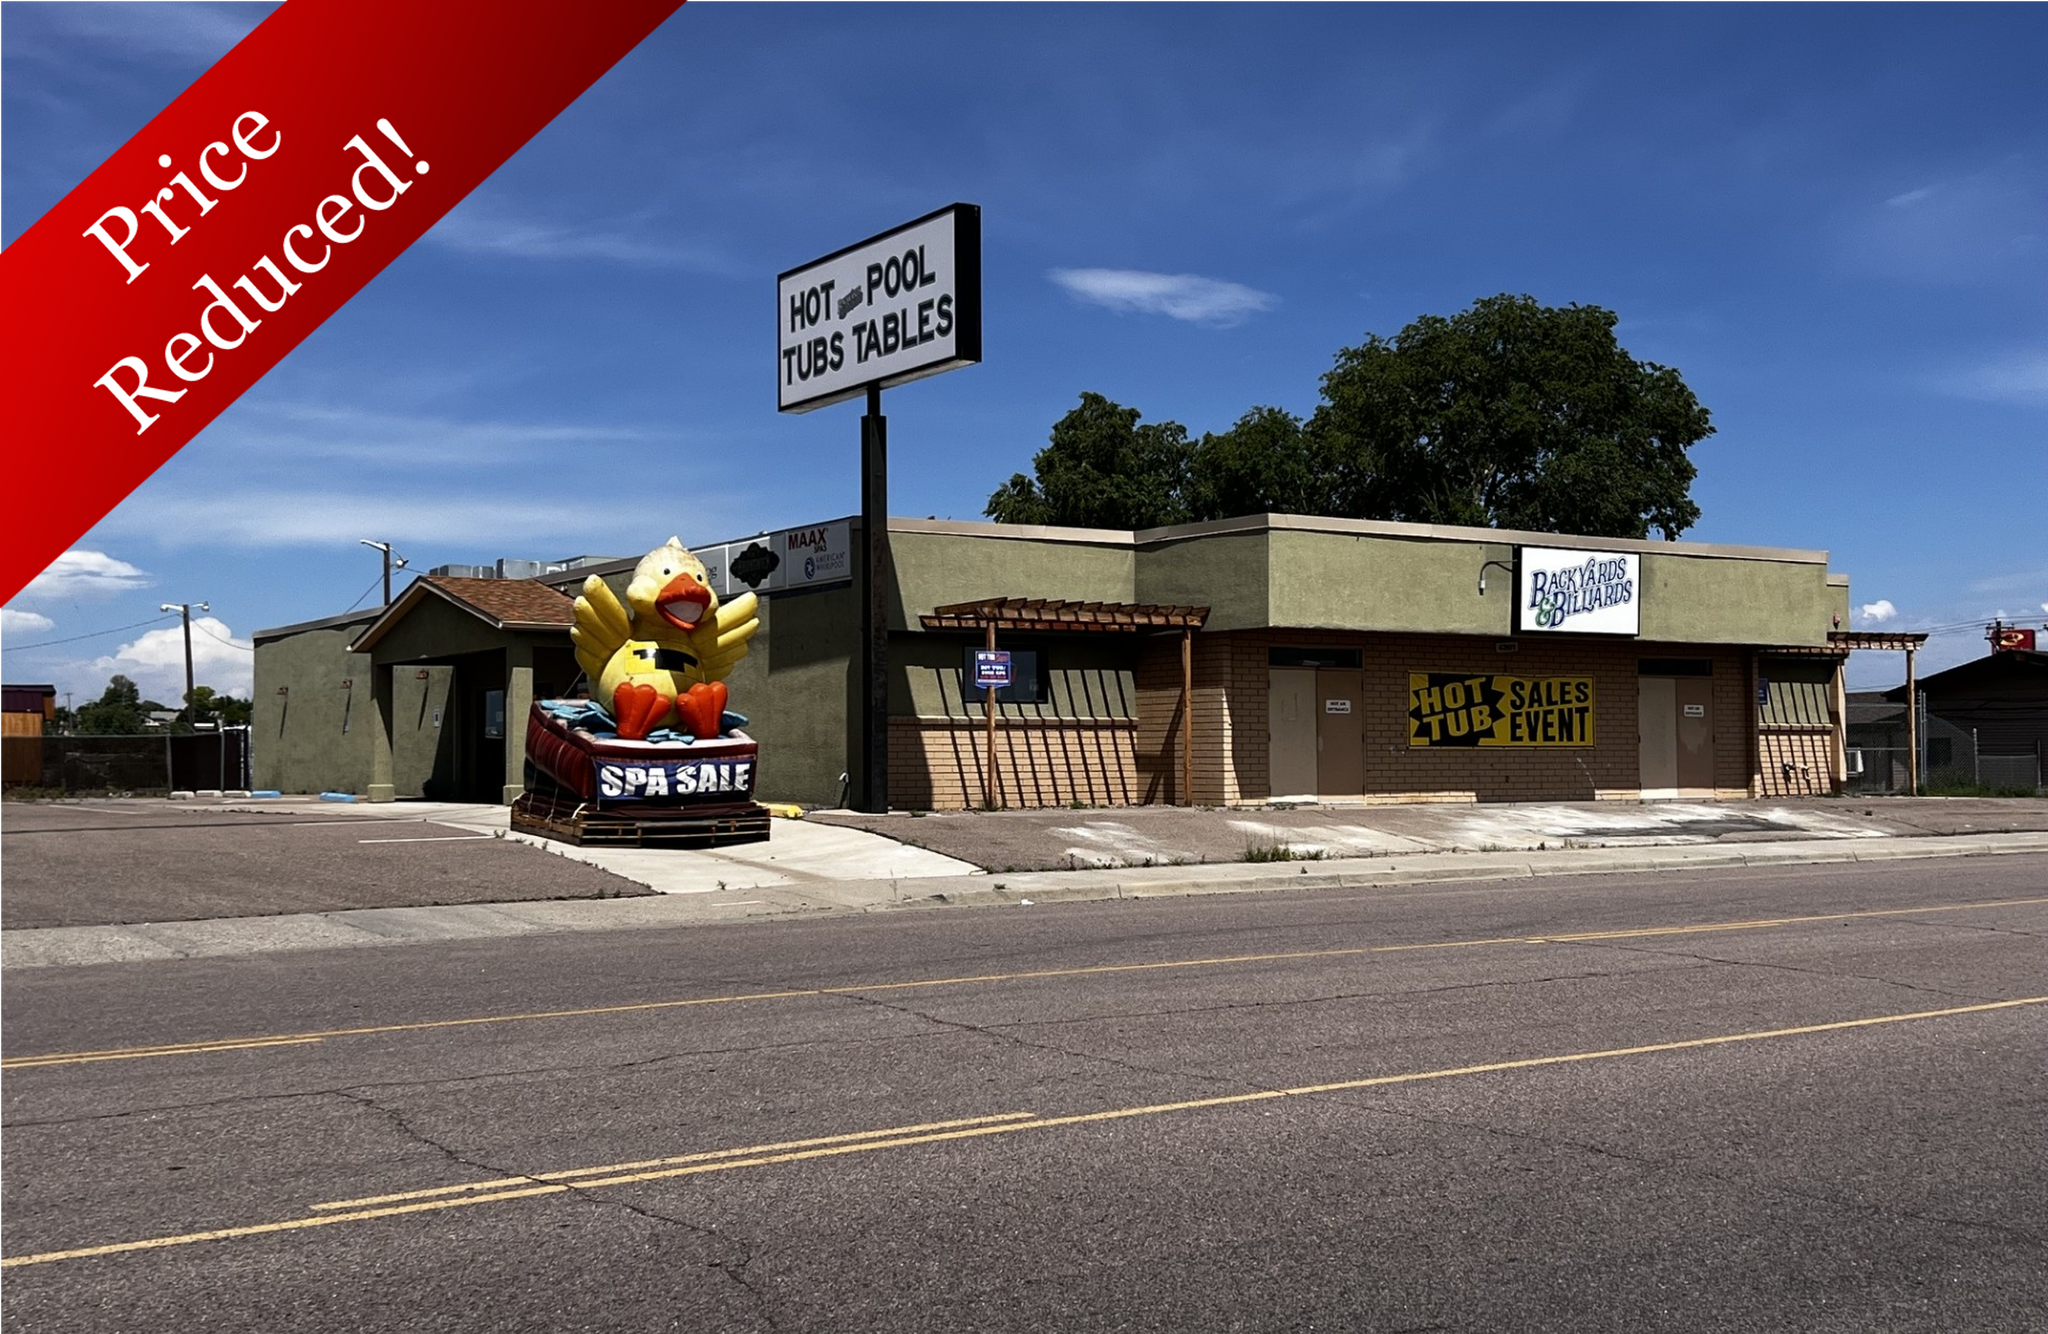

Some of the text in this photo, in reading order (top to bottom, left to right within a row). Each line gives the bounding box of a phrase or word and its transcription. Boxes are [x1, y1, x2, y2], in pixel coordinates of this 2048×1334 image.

[790, 279, 835, 333] HOT
[867, 244, 936, 306] POOL
[783, 331, 844, 386] TUBS
[852, 293, 954, 364] TABLES
[788, 528, 827, 550] MAAX
[1529, 557, 1627, 609] BACKYARDS
[1535, 579, 1633, 628] & BILLIARDS
[1418, 676, 1590, 715] HOT SALES
[1422, 704, 1590, 742] TUB EVENT
[600, 763, 751, 797] SPA SALE
